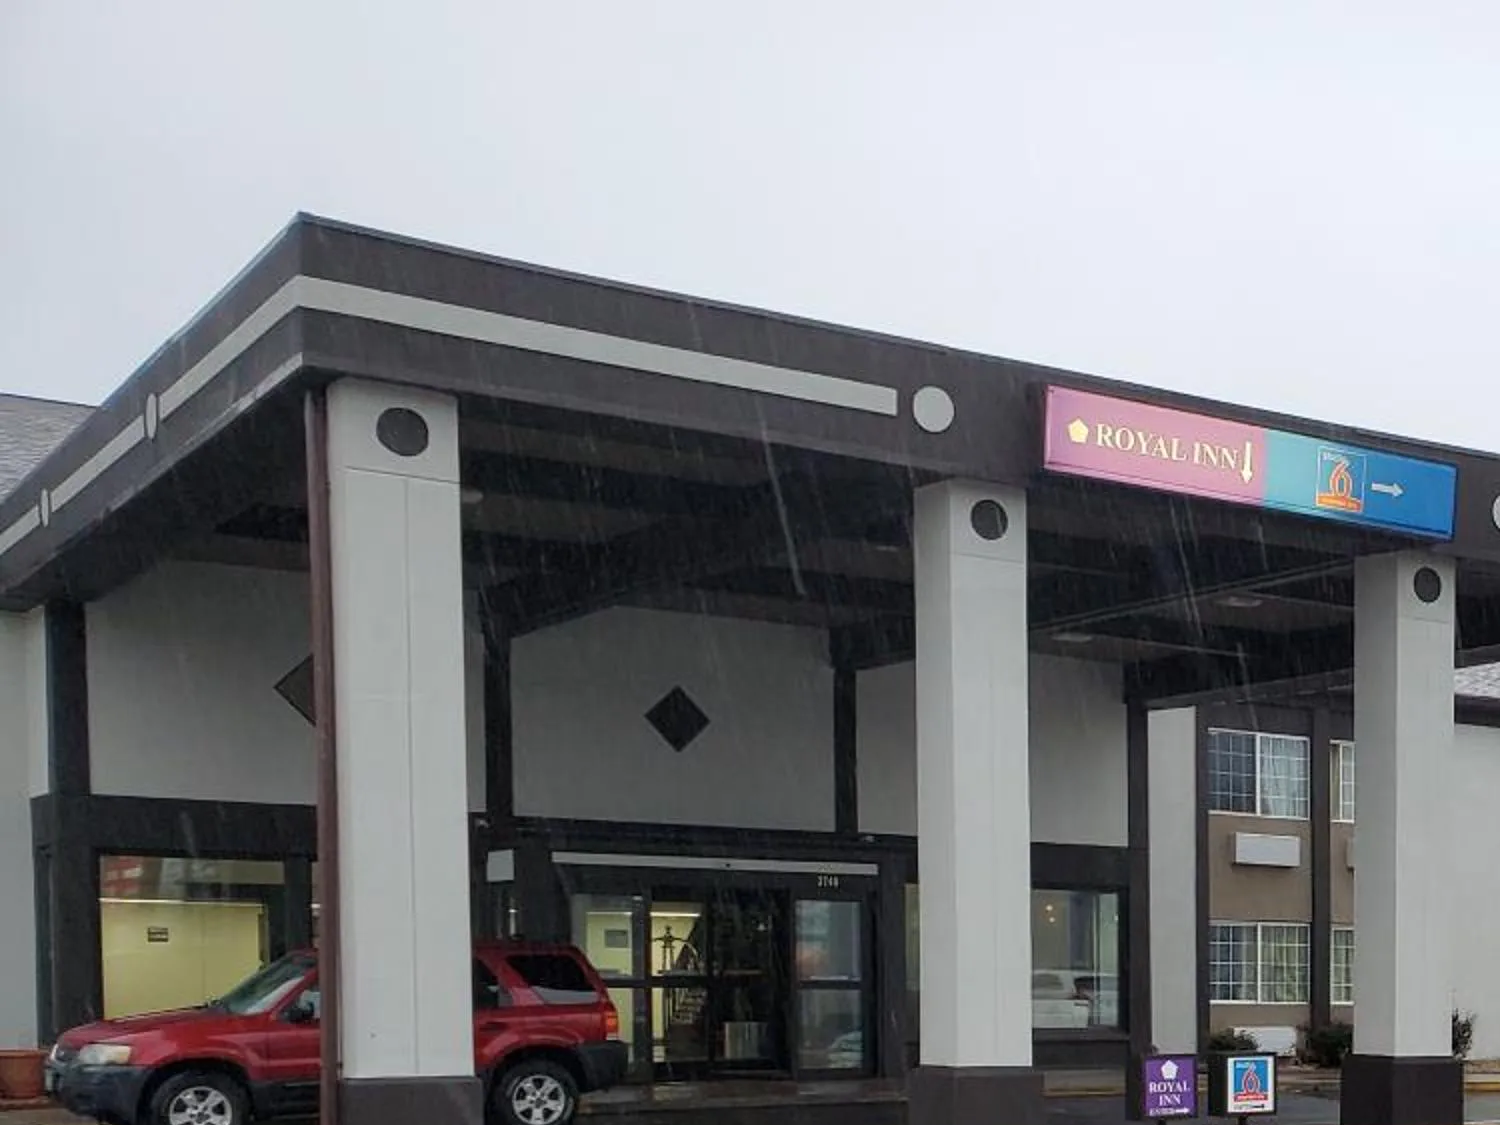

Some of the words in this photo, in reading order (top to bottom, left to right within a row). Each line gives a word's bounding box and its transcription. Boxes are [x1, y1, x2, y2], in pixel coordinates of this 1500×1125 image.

[1096, 423, 1187, 462] ROYAL
[1193, 441, 1238, 470] INN
[1149, 1081, 1191, 1093] ROYAL
[1159, 1094, 1181, 1106] INN
